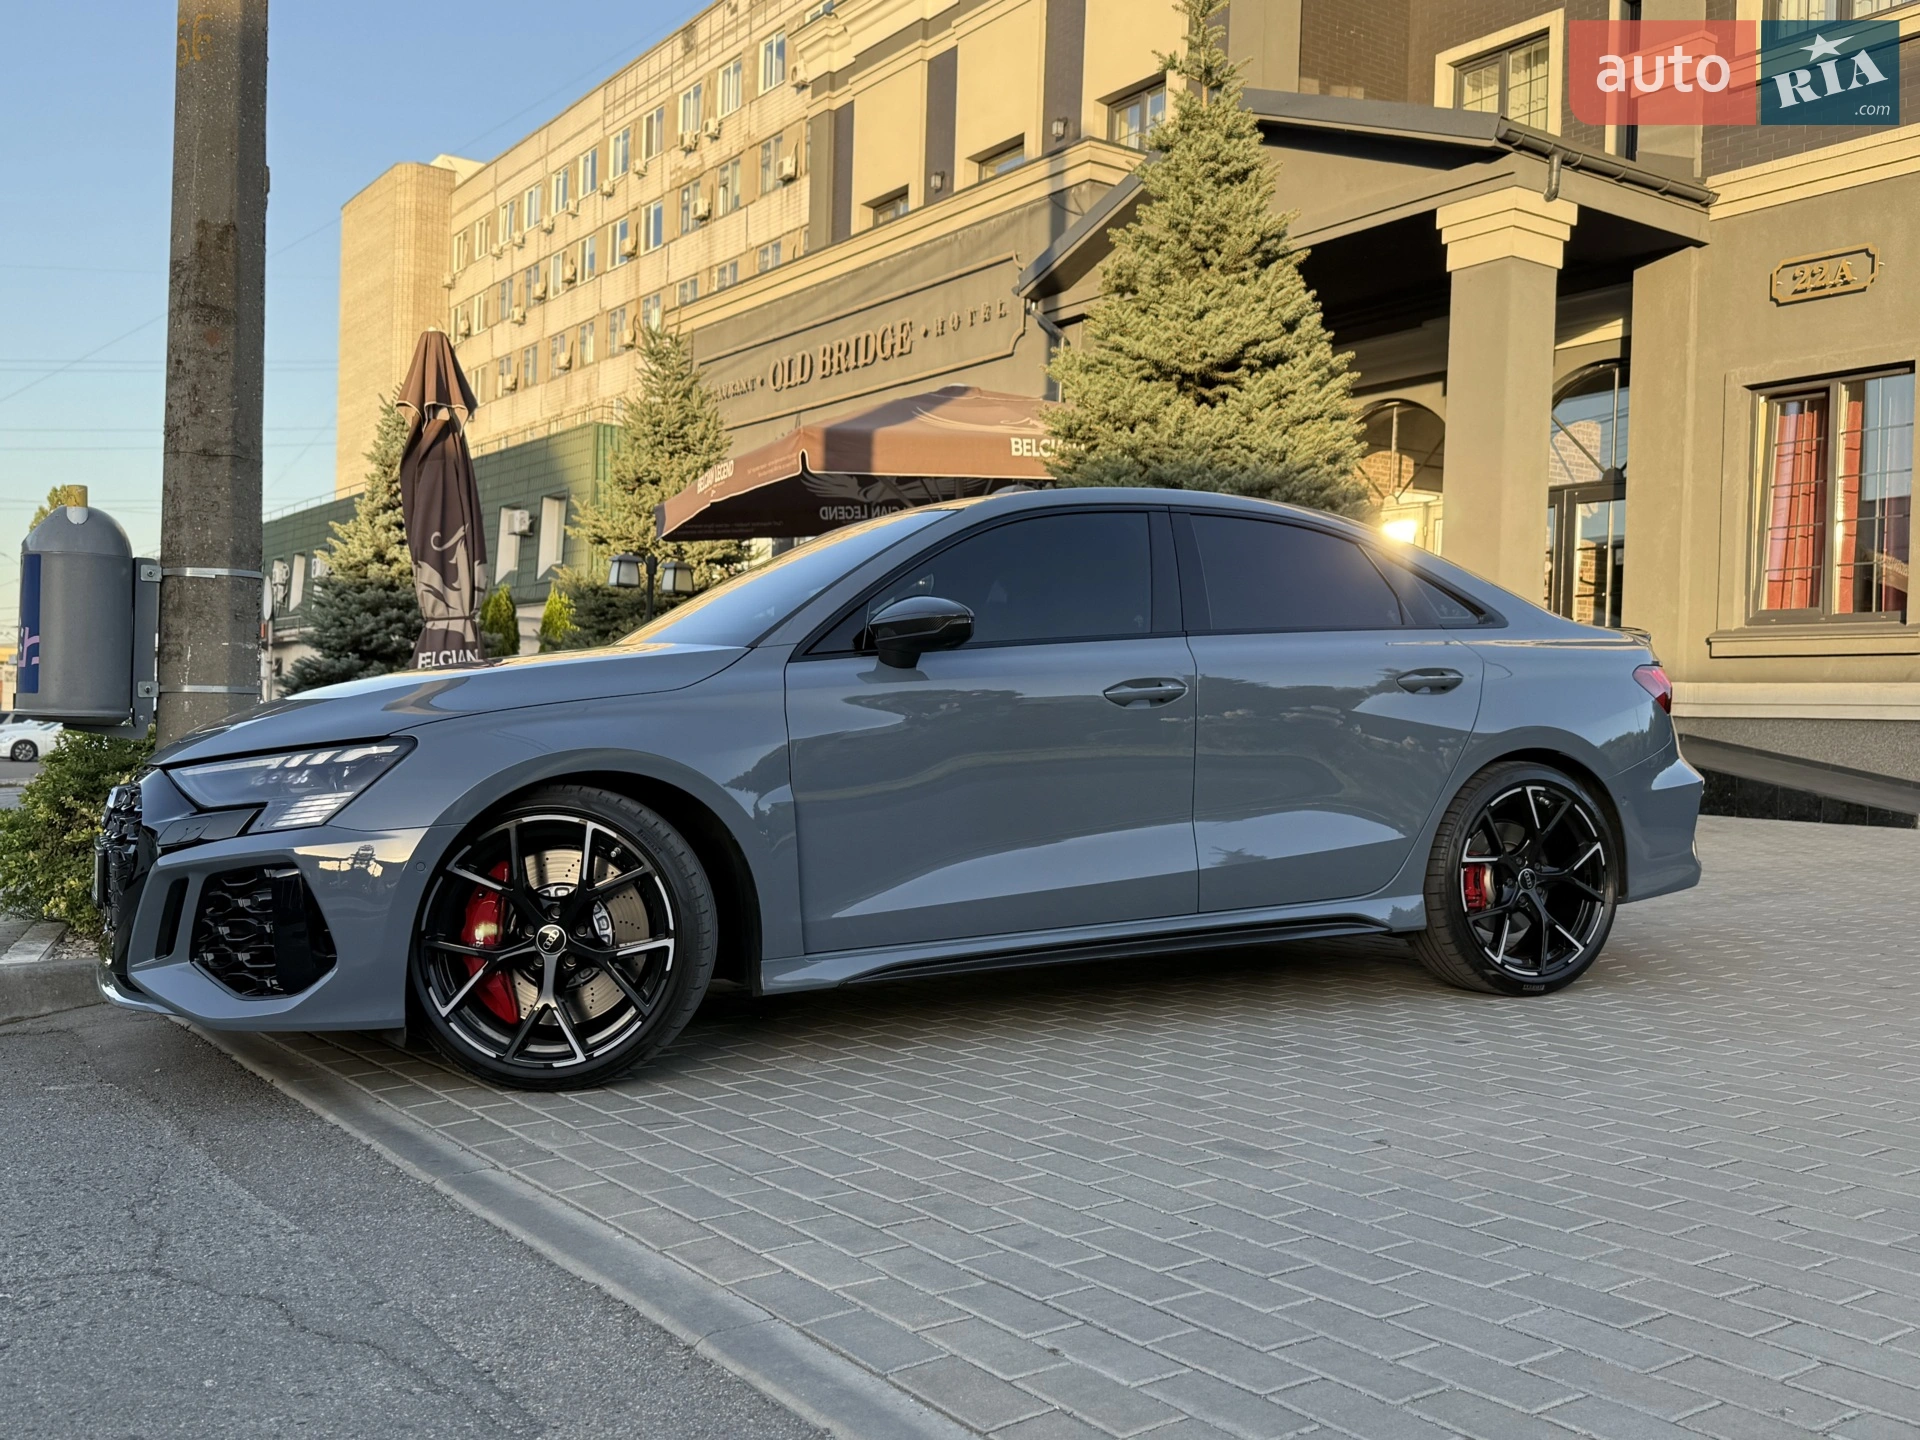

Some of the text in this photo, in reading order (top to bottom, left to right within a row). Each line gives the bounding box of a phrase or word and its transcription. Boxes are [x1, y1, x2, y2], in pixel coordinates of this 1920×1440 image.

[1792, 259, 1855, 292] 22A
[768, 350, 813, 392] OLD
[818, 317, 913, 380] BRIDGE
[933, 298, 1009, 338] HOTEL
[714, 459, 734, 483] LEGEND
